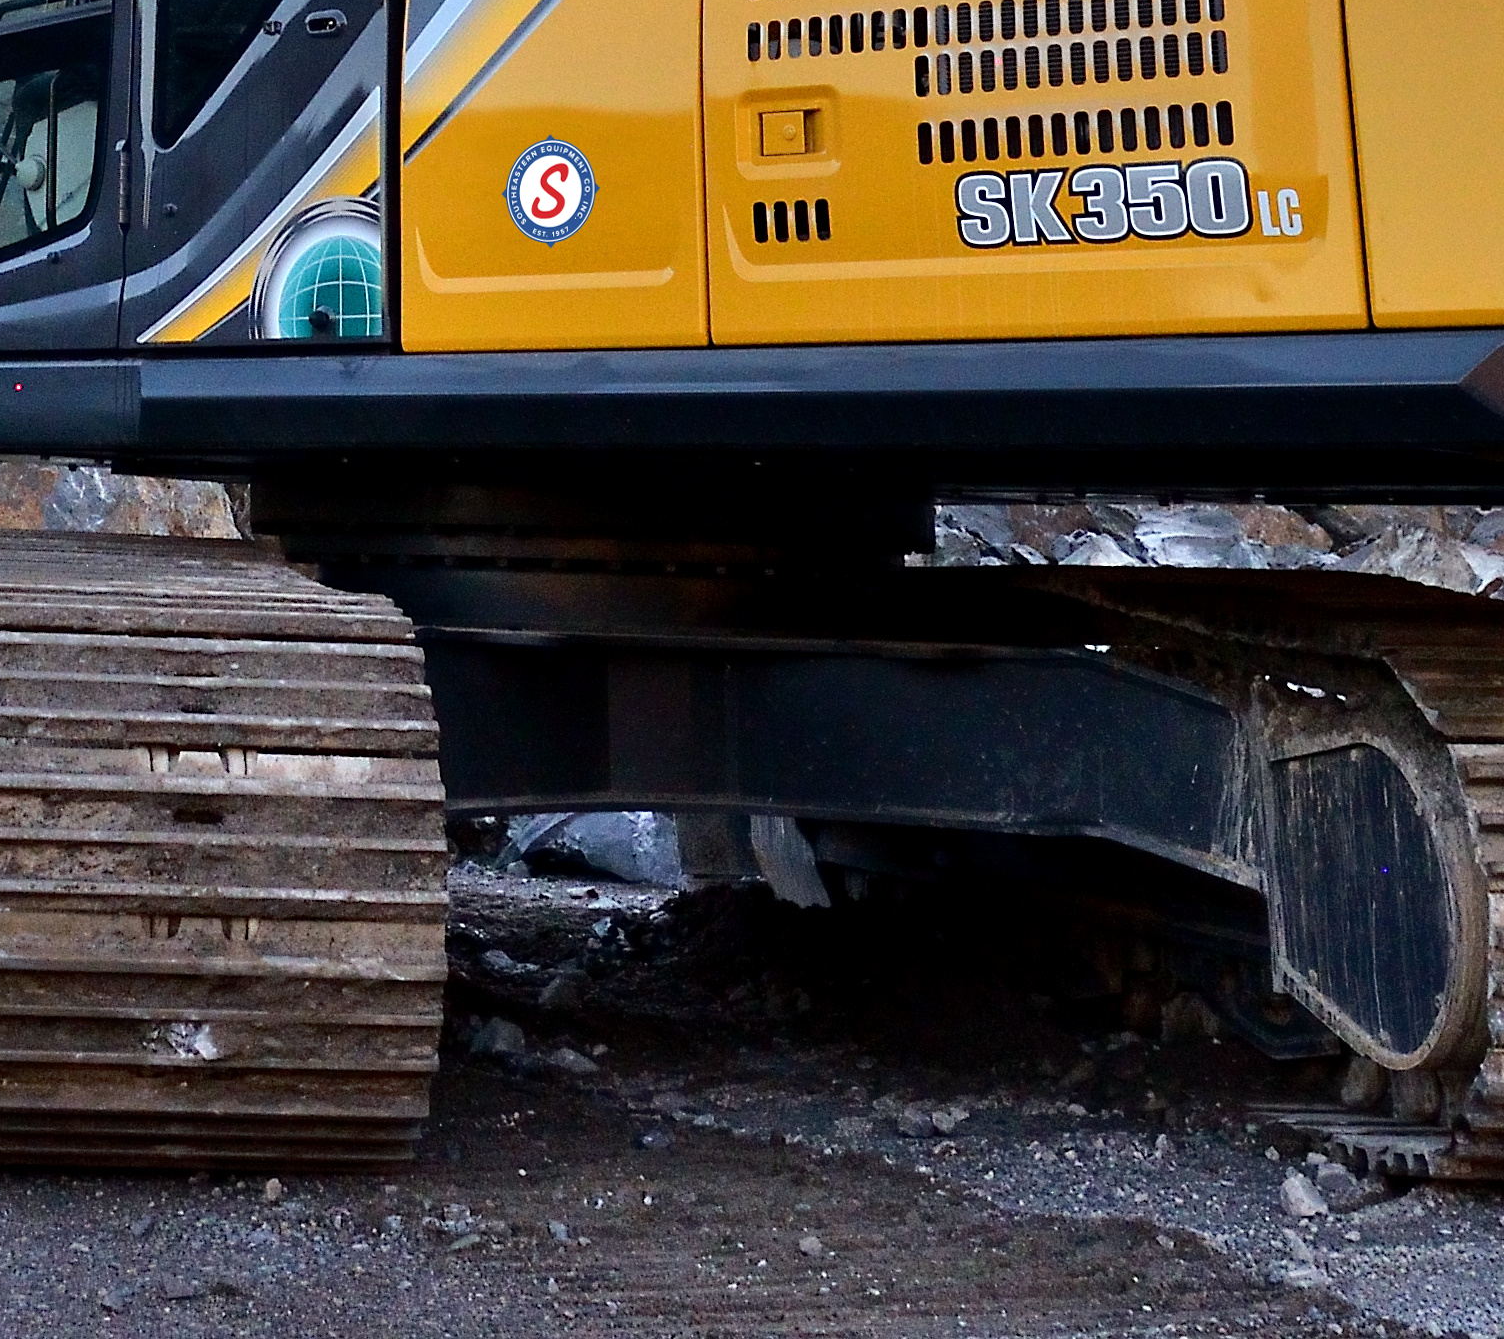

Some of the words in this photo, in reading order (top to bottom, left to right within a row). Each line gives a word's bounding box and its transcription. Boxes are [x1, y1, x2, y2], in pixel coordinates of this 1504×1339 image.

[511, 150, 538, 225] SOUTHEASTERN
[540, 144, 588, 174] EQUIPMENT
[531, 163, 569, 220] S
[956, 157, 1253, 248] SK350
[1257, 187, 1304, 237] LC
[551, 225, 569, 237] 1957
